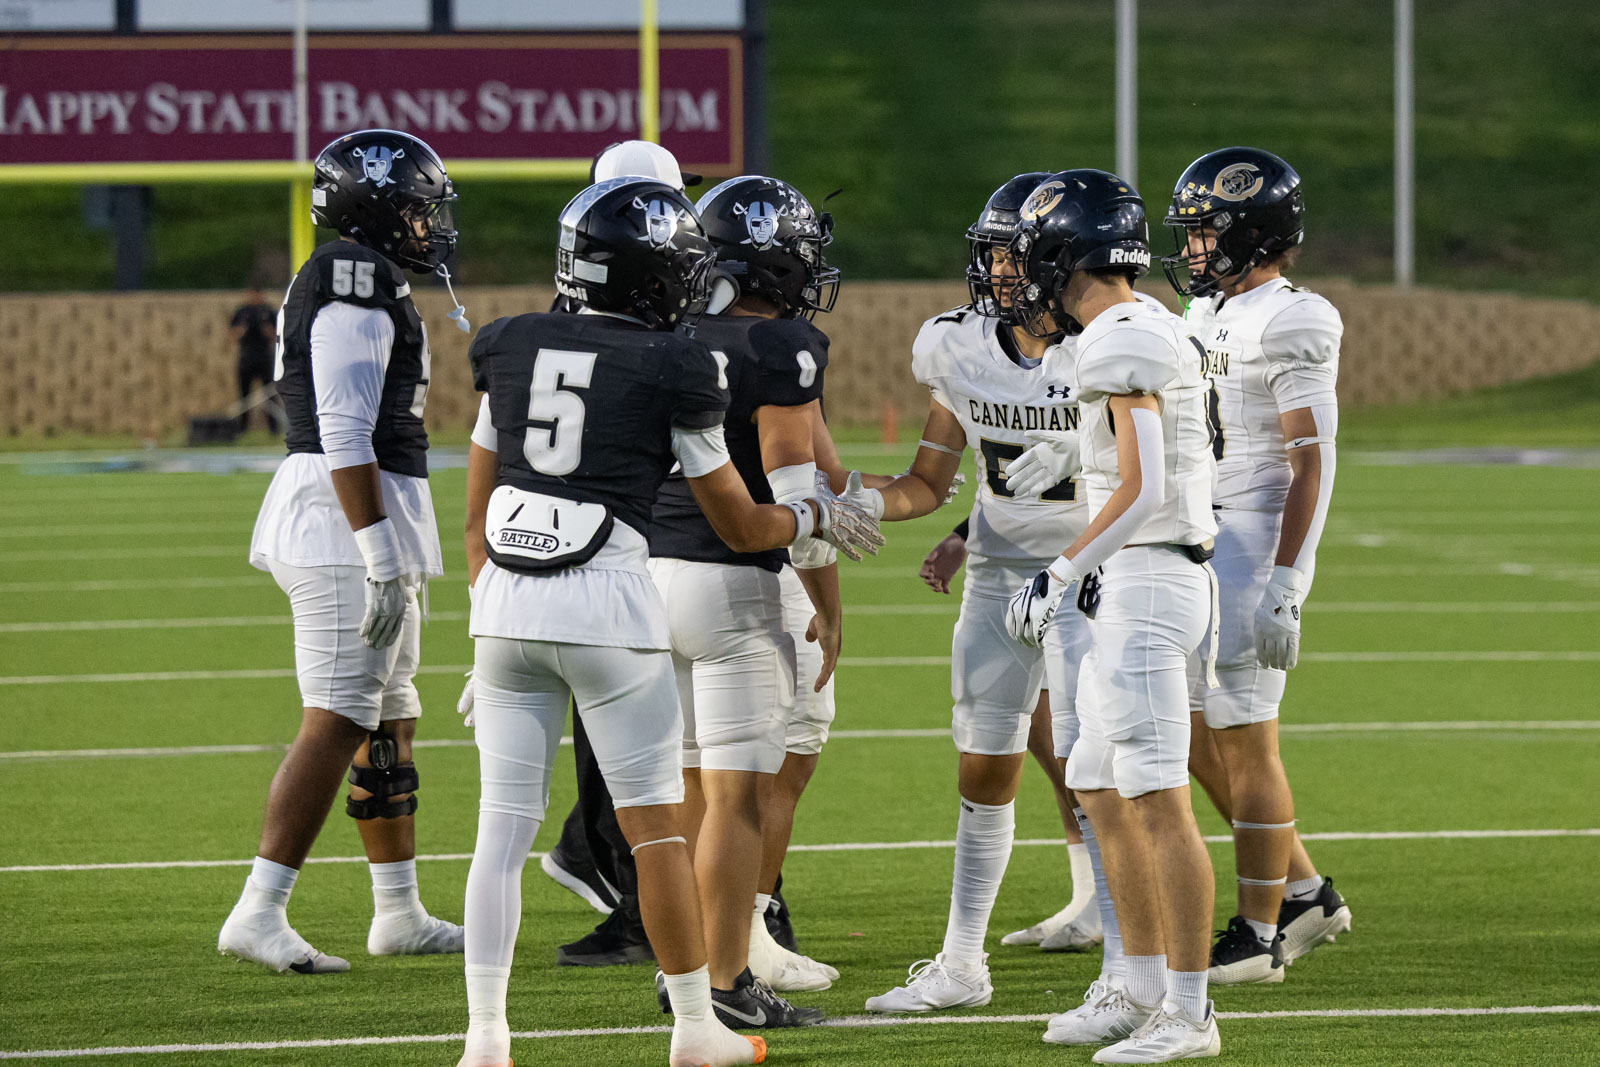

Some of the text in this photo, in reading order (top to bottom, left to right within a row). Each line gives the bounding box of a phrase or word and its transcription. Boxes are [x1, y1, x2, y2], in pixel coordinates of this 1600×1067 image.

[0, 84, 137, 134] APPY
[320, 81, 471, 132] BANK
[332, 258, 376, 299] 55
[523, 348, 598, 476] 5
[969, 399, 1079, 431] CANADIAN
[500, 531, 553, 549] BATTLE
